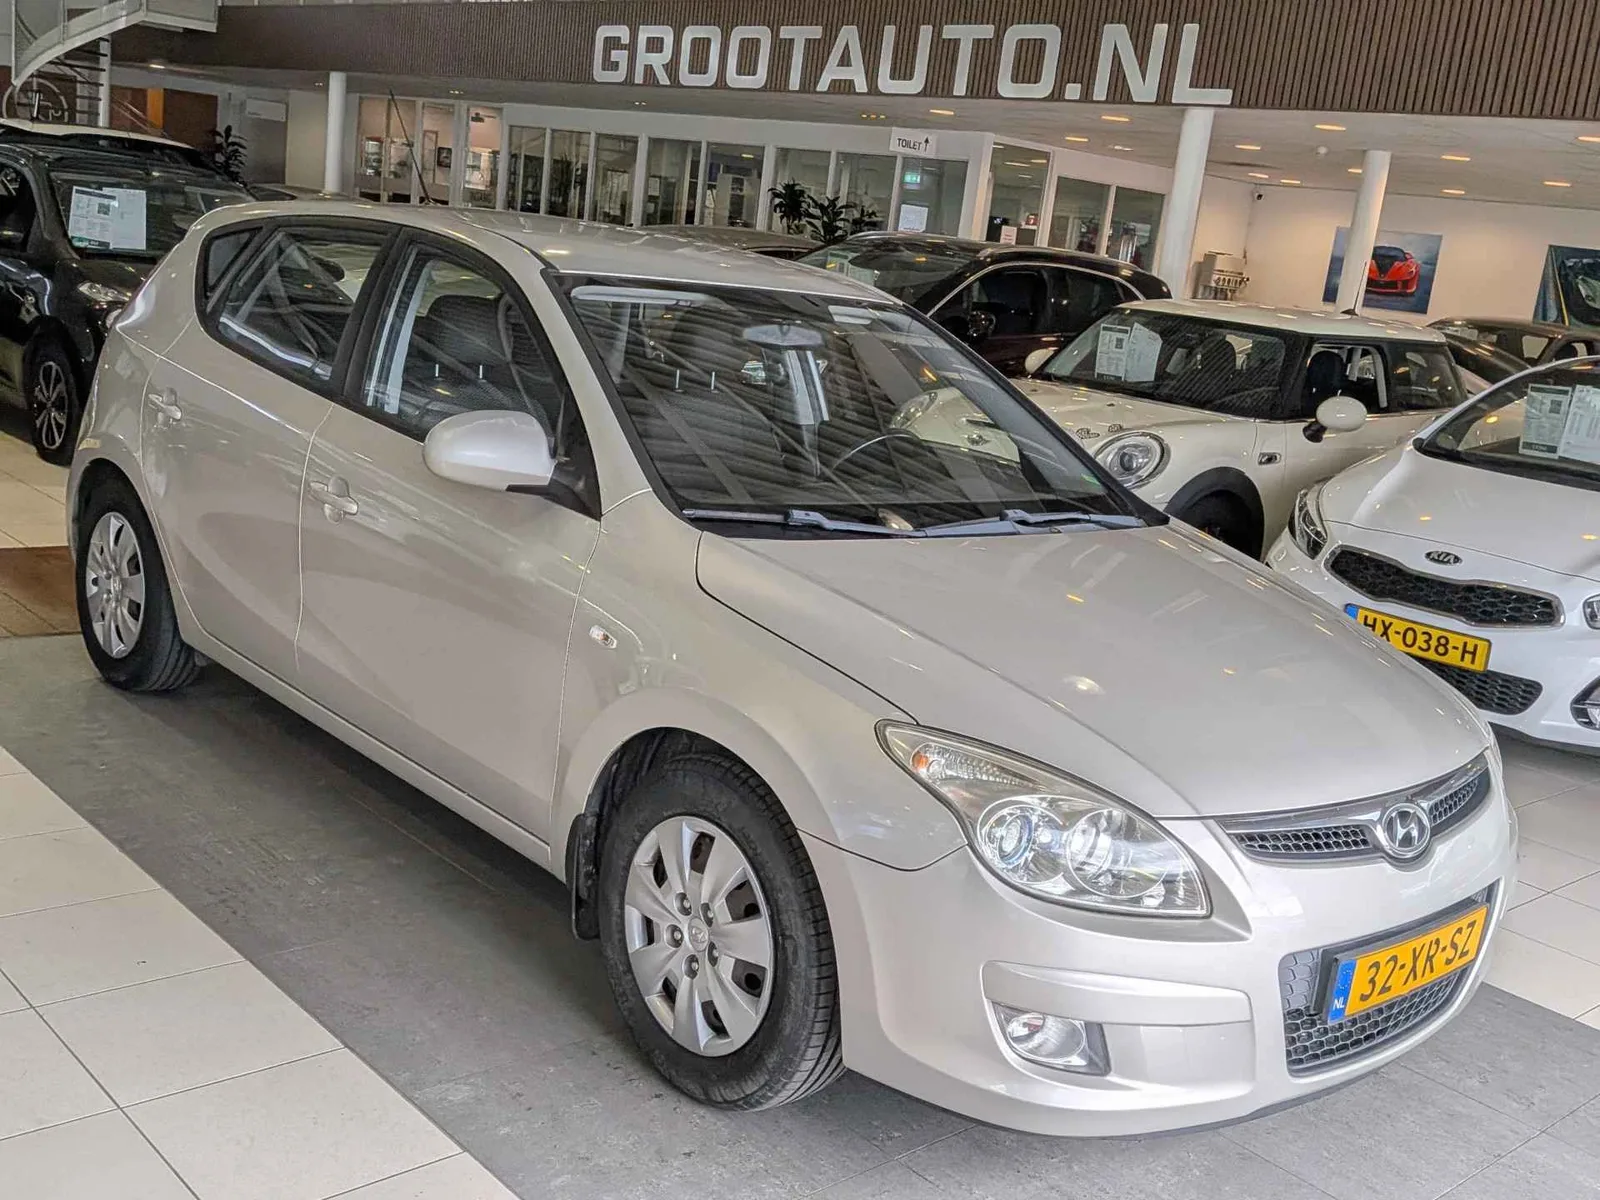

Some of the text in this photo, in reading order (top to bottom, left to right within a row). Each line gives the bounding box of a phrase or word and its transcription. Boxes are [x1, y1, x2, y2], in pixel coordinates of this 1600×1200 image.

[592, 23, 1233, 106] GROOTAUTO.NL
[896, 137, 922, 151] TOILET
[1429, 550, 1457, 565] KIA
[1332, 919, 1477, 1010] NL 32-XR-SZ
